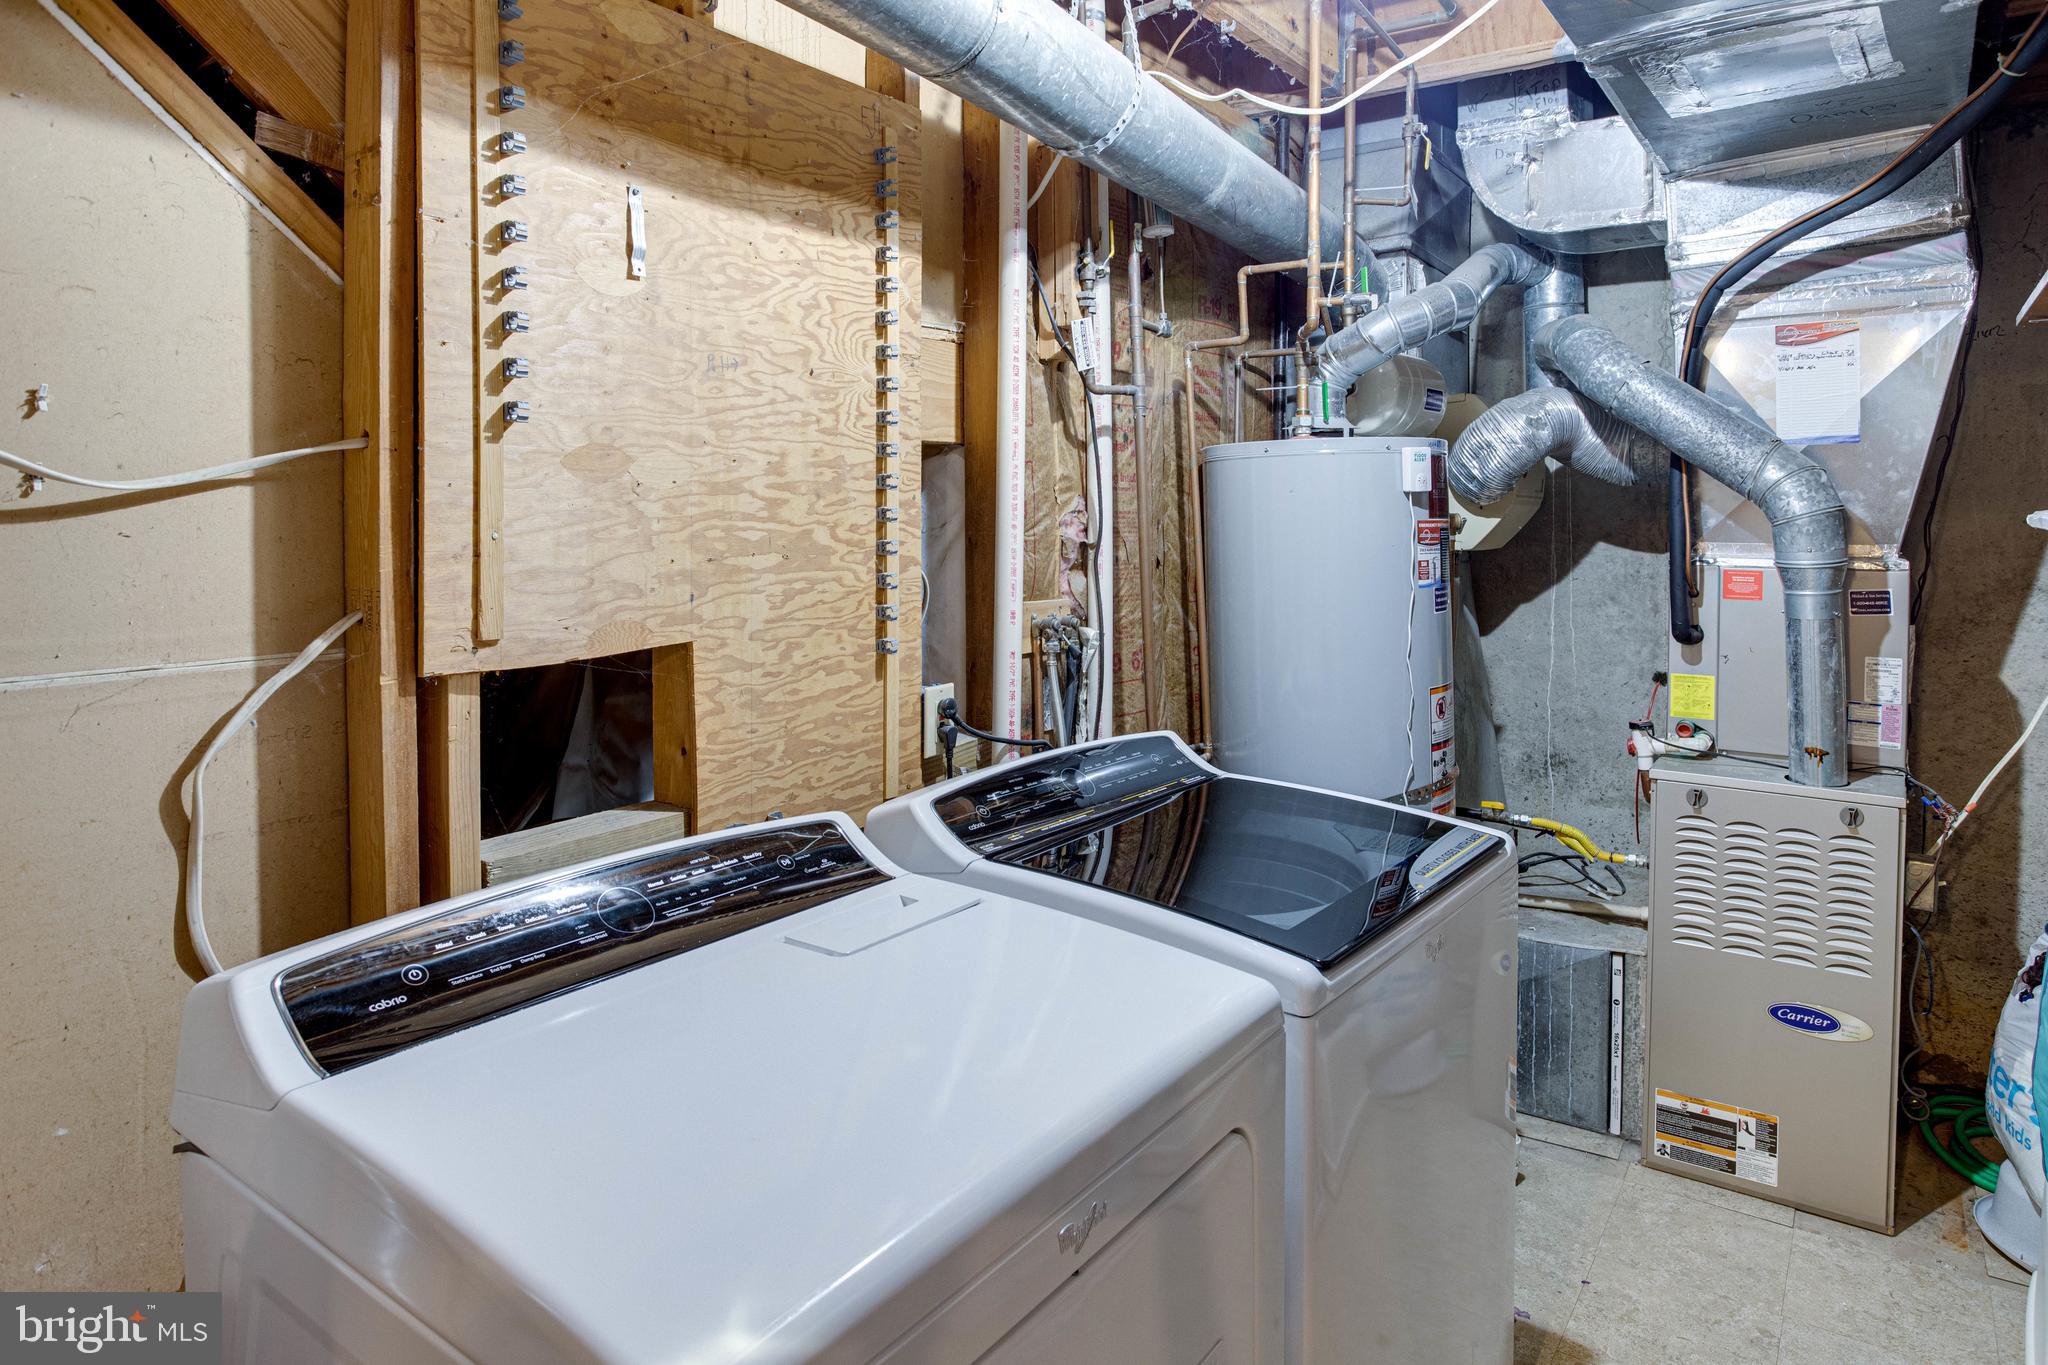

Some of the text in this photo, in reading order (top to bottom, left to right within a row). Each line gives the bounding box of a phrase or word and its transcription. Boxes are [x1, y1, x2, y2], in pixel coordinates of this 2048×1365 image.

[465, 931, 487, 941] Casuals
[497, 923, 516, 932] Towels
[524, 914, 548, 924] Delicates
[647, 879, 665, 888] Normal
[368, 995, 408, 1013] cabrio
[1777, 1008, 1831, 1027] Carrier
[2004, 1114, 2033, 1151] kids
